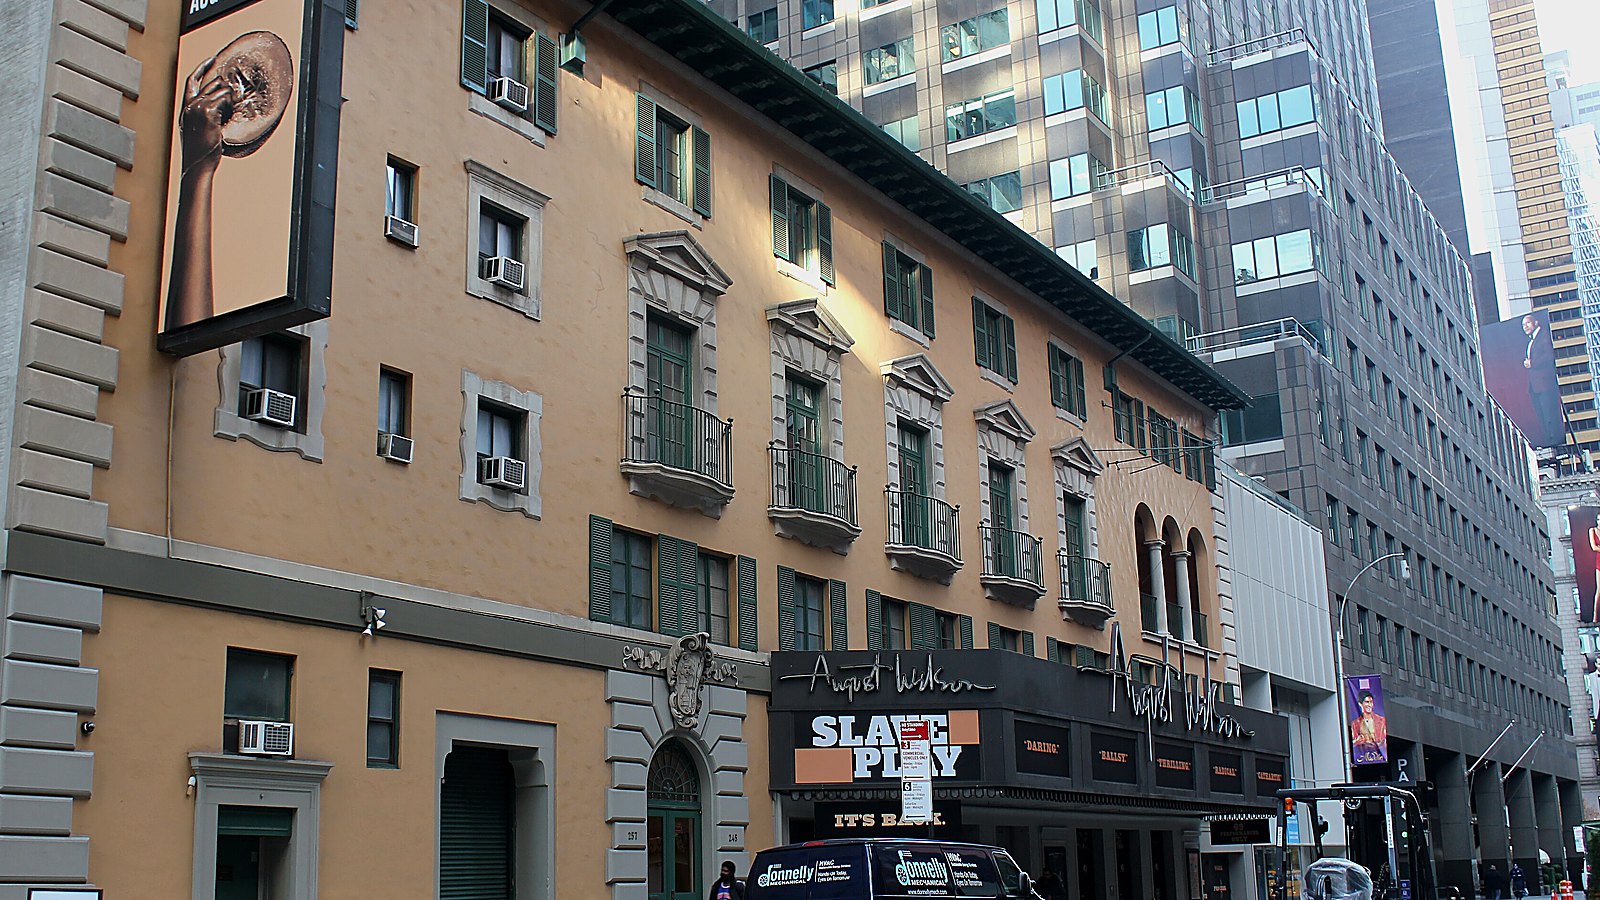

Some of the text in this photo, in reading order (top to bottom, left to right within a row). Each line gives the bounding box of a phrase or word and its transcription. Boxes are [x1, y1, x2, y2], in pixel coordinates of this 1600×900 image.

[780, 652, 997, 702] August Wilson
[854, 746, 962, 778] PLY
[834, 813, 876, 828] IT'S
[728, 833, 738, 843] 245
[911, 879, 947, 887] MECHANICAL
